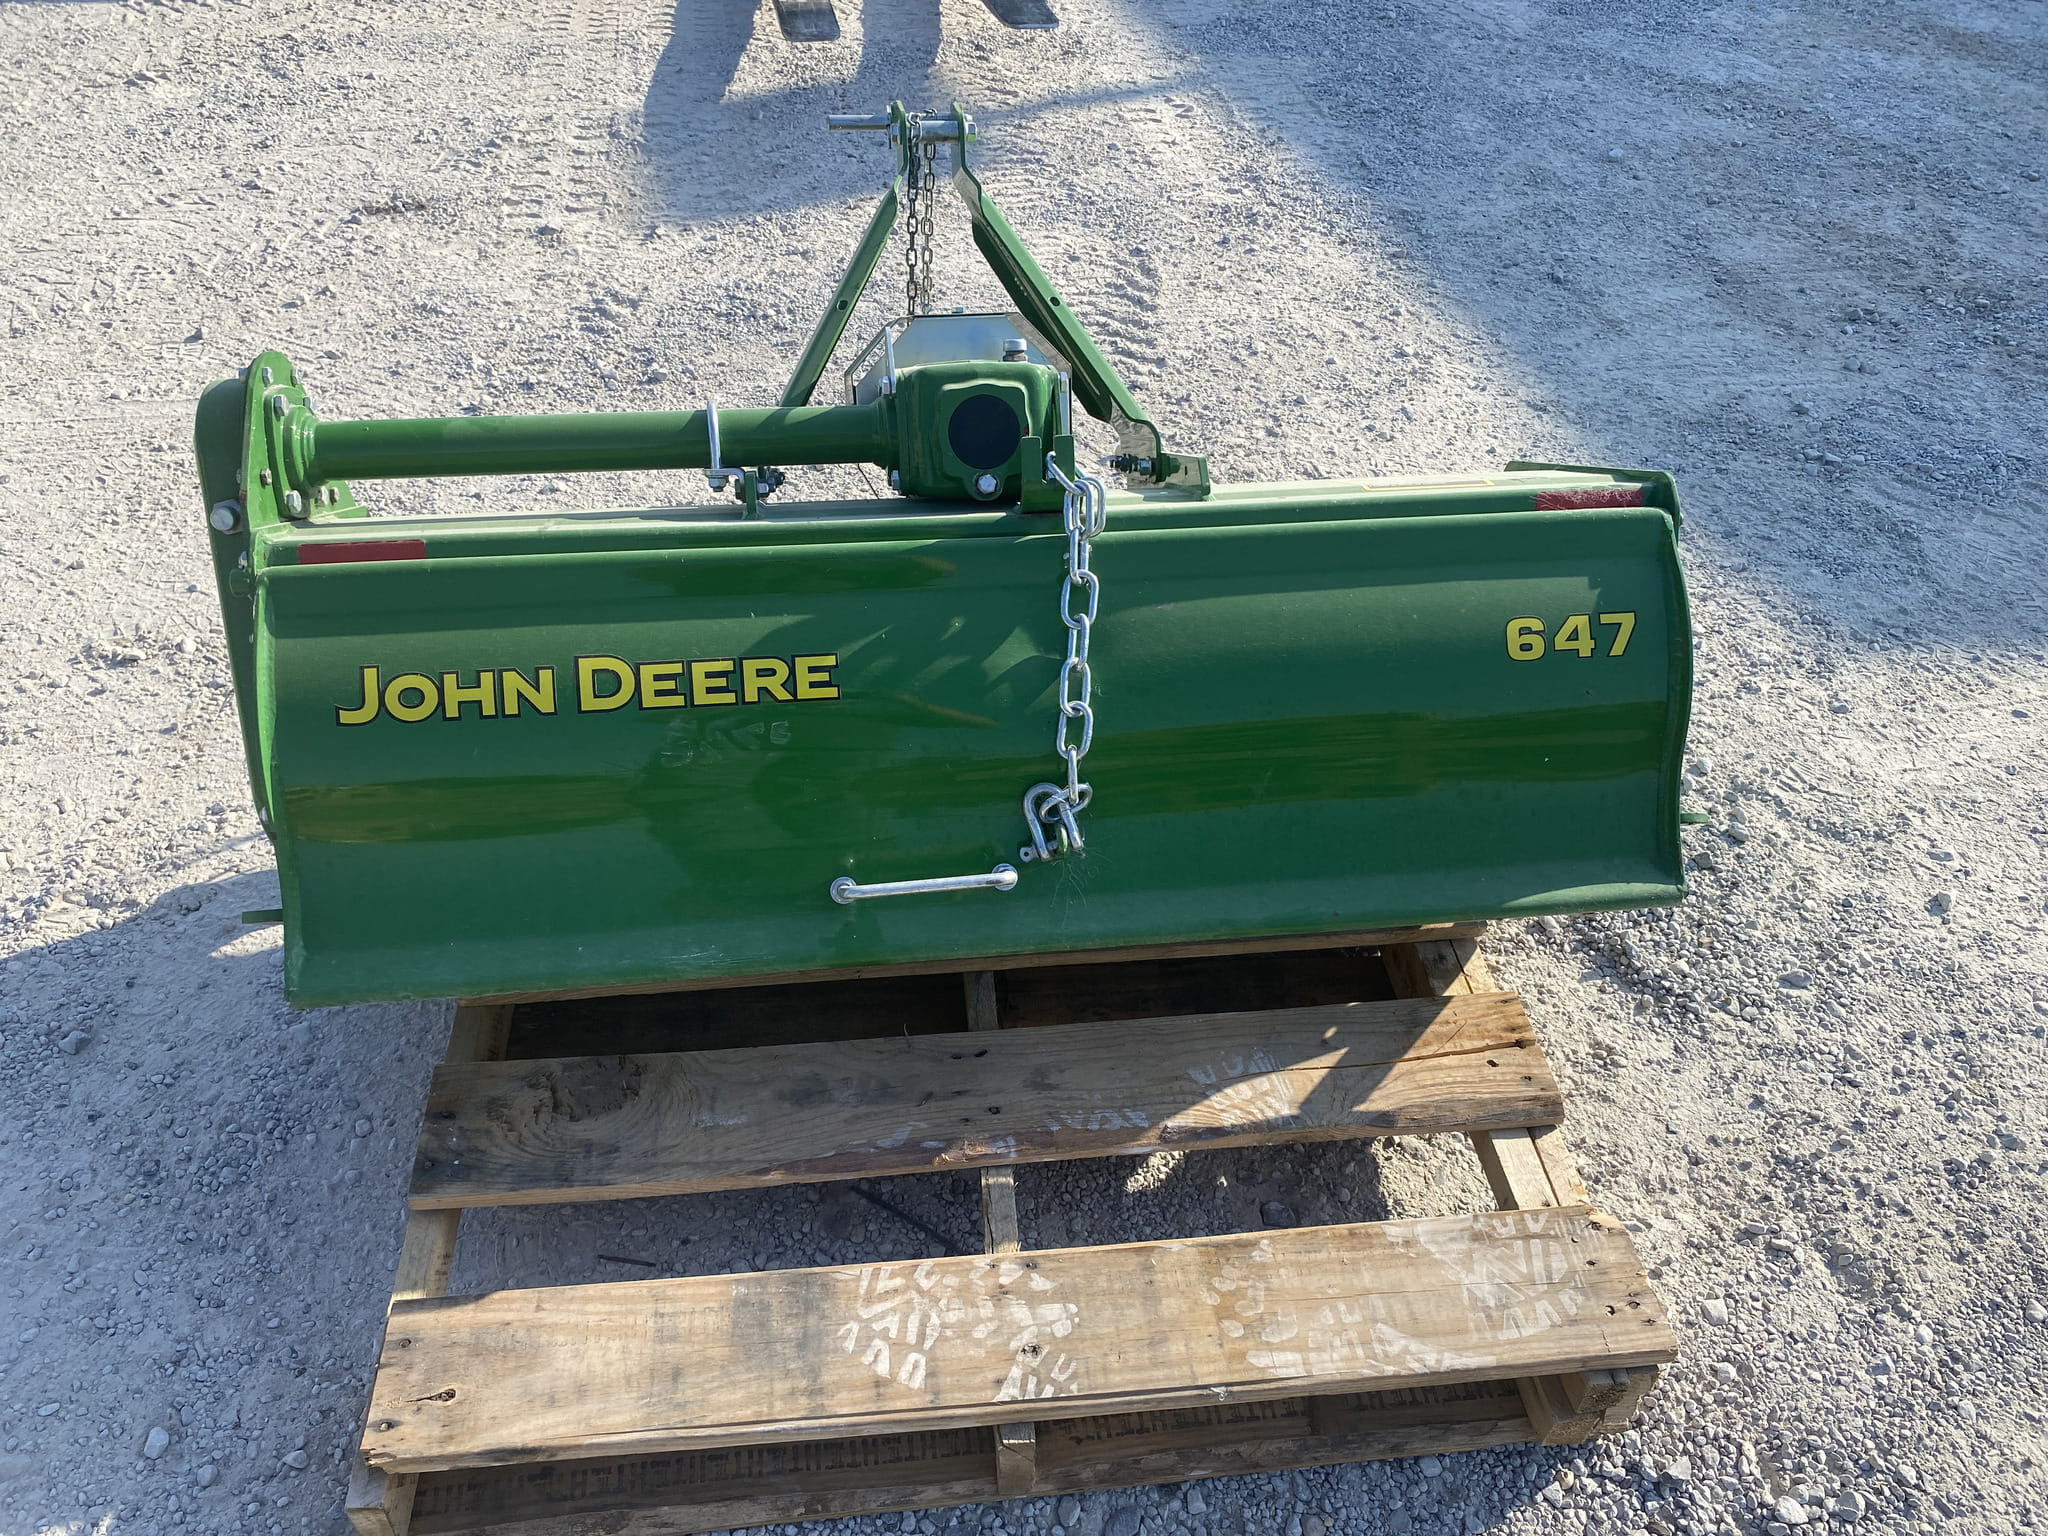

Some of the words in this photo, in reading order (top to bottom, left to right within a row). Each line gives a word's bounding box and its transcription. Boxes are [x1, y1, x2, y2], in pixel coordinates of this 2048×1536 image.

[1505, 611, 1637, 661] 647
[336, 664, 558, 727] JOHN
[573, 652, 841, 714] DEERE
